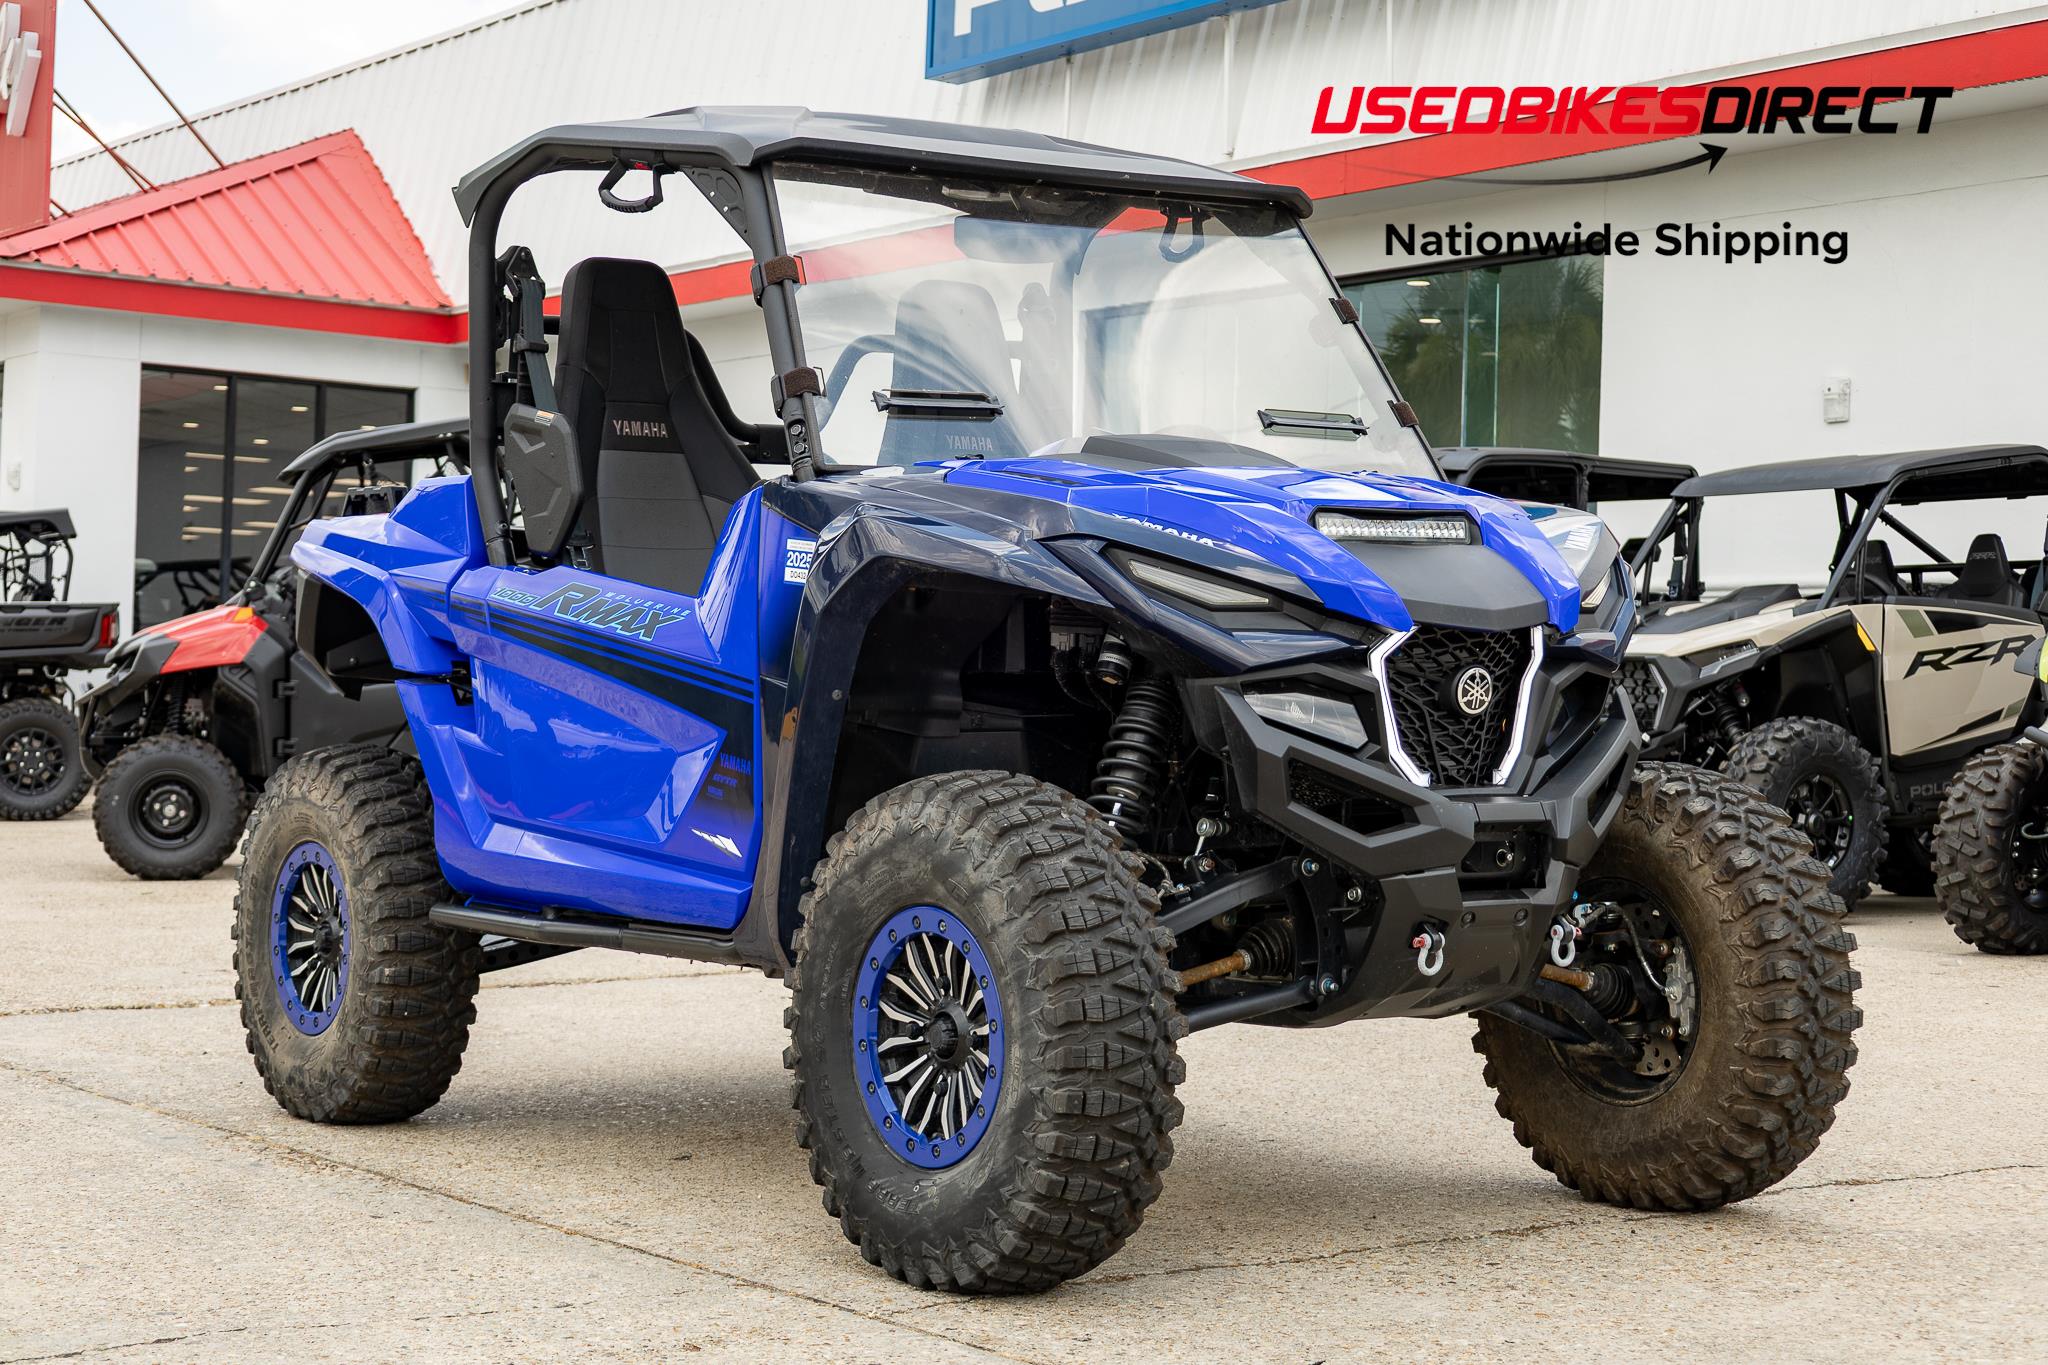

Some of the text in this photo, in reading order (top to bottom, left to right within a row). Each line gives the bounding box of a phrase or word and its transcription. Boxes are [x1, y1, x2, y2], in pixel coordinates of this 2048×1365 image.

[612, 419, 669, 439] YAMAHA
[943, 433, 993, 451] YAMAHA
[786, 551, 814, 569] 2025
[487, 581, 687, 641] 1000 RMAX
[605, 591, 691, 617] WOLVERINE
[1902, 633, 2038, 680] RZR
[719, 752, 752, 776] YAMAHA
